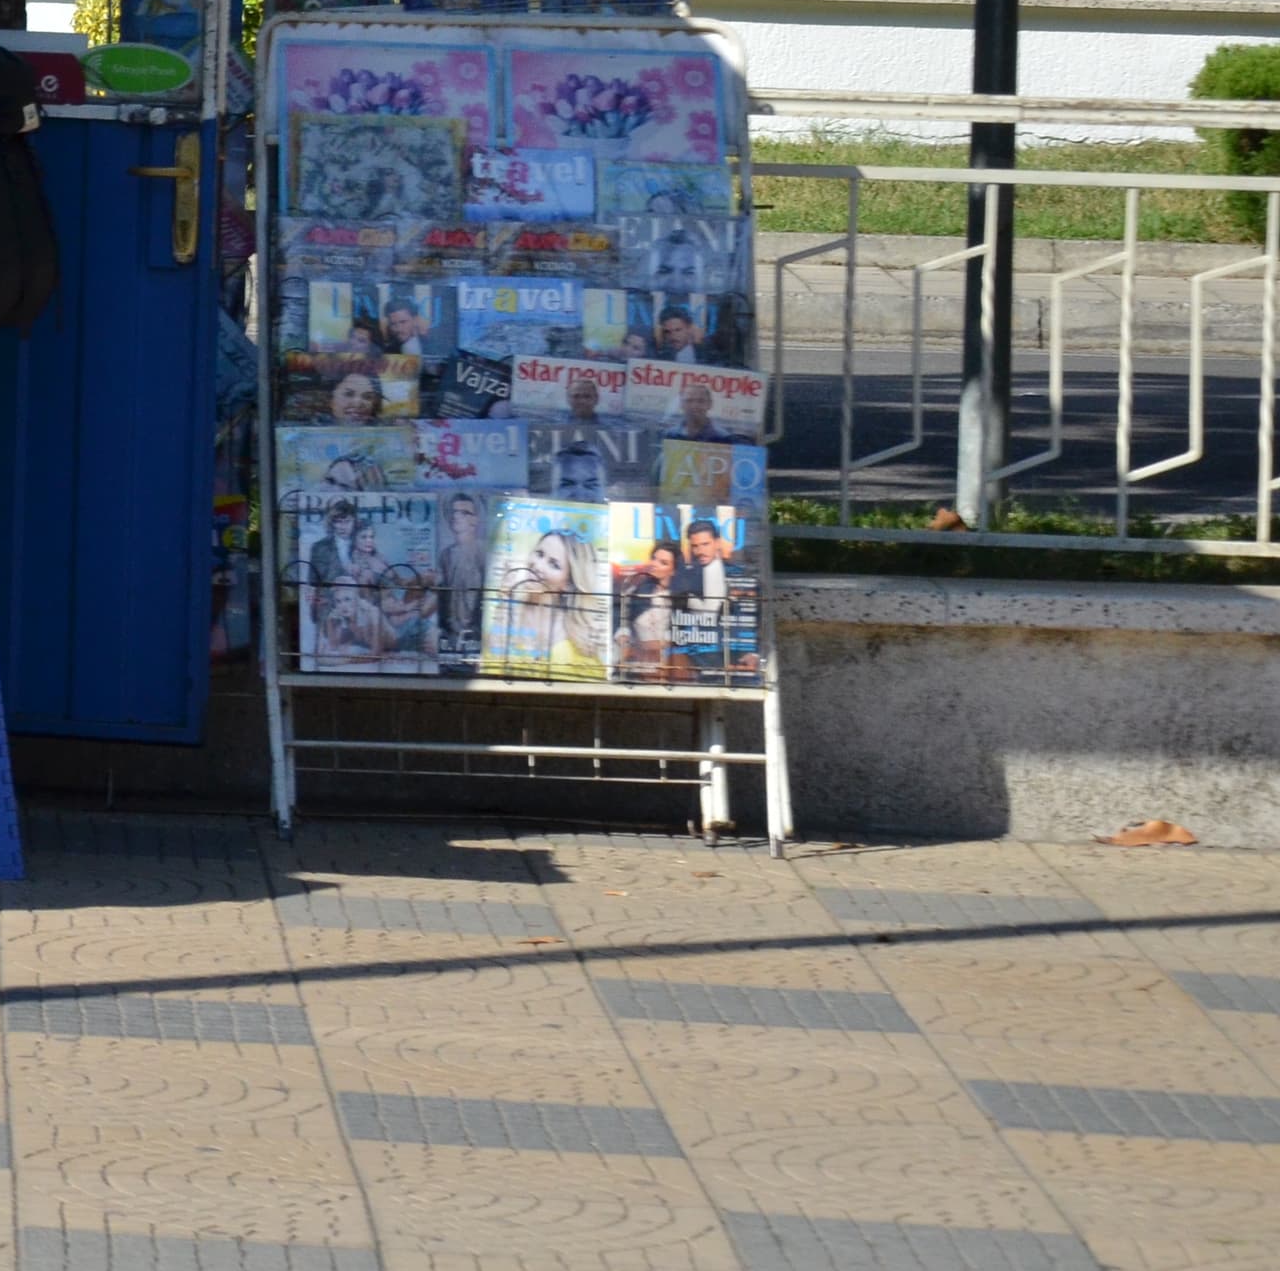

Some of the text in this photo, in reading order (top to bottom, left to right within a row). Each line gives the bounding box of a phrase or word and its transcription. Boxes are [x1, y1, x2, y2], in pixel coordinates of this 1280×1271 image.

[458, 281, 578, 315] travel
[455, 360, 510, 399] Vajza
[518, 359, 627, 393] star peop
[631, 363, 678, 386] star
[418, 425, 520, 457] ravel
[676, 450, 762, 492] APO
